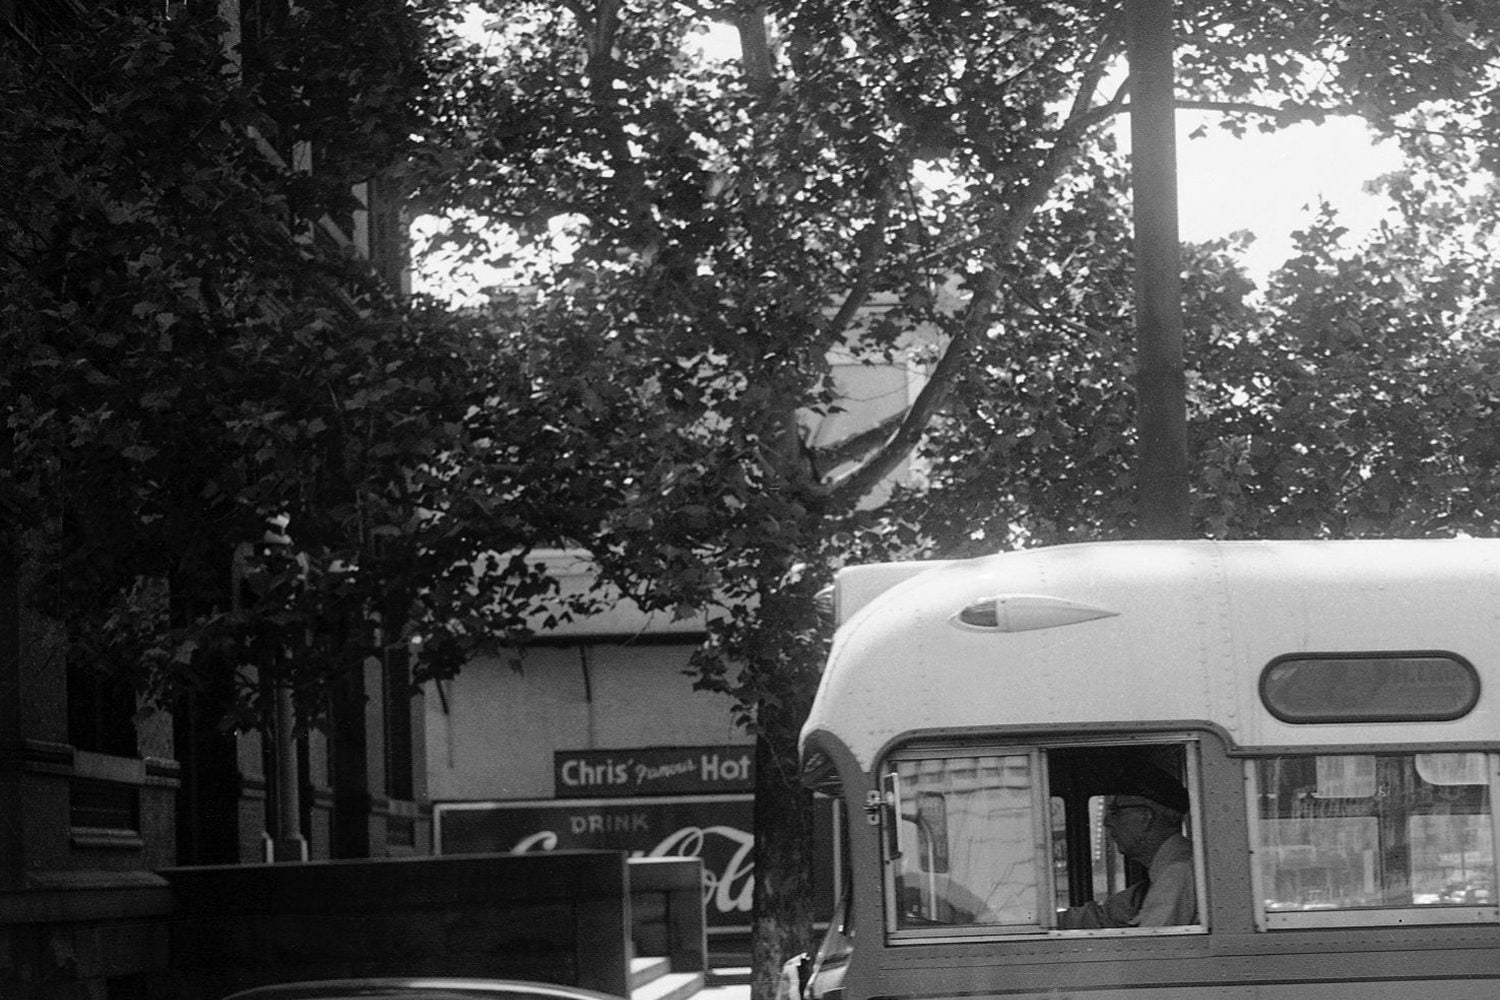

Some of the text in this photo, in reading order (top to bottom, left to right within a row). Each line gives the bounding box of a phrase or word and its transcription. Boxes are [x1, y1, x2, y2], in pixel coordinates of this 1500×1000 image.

[561, 754, 752, 786] Chris' Famous Hot
[569, 813, 649, 835] DRINK
